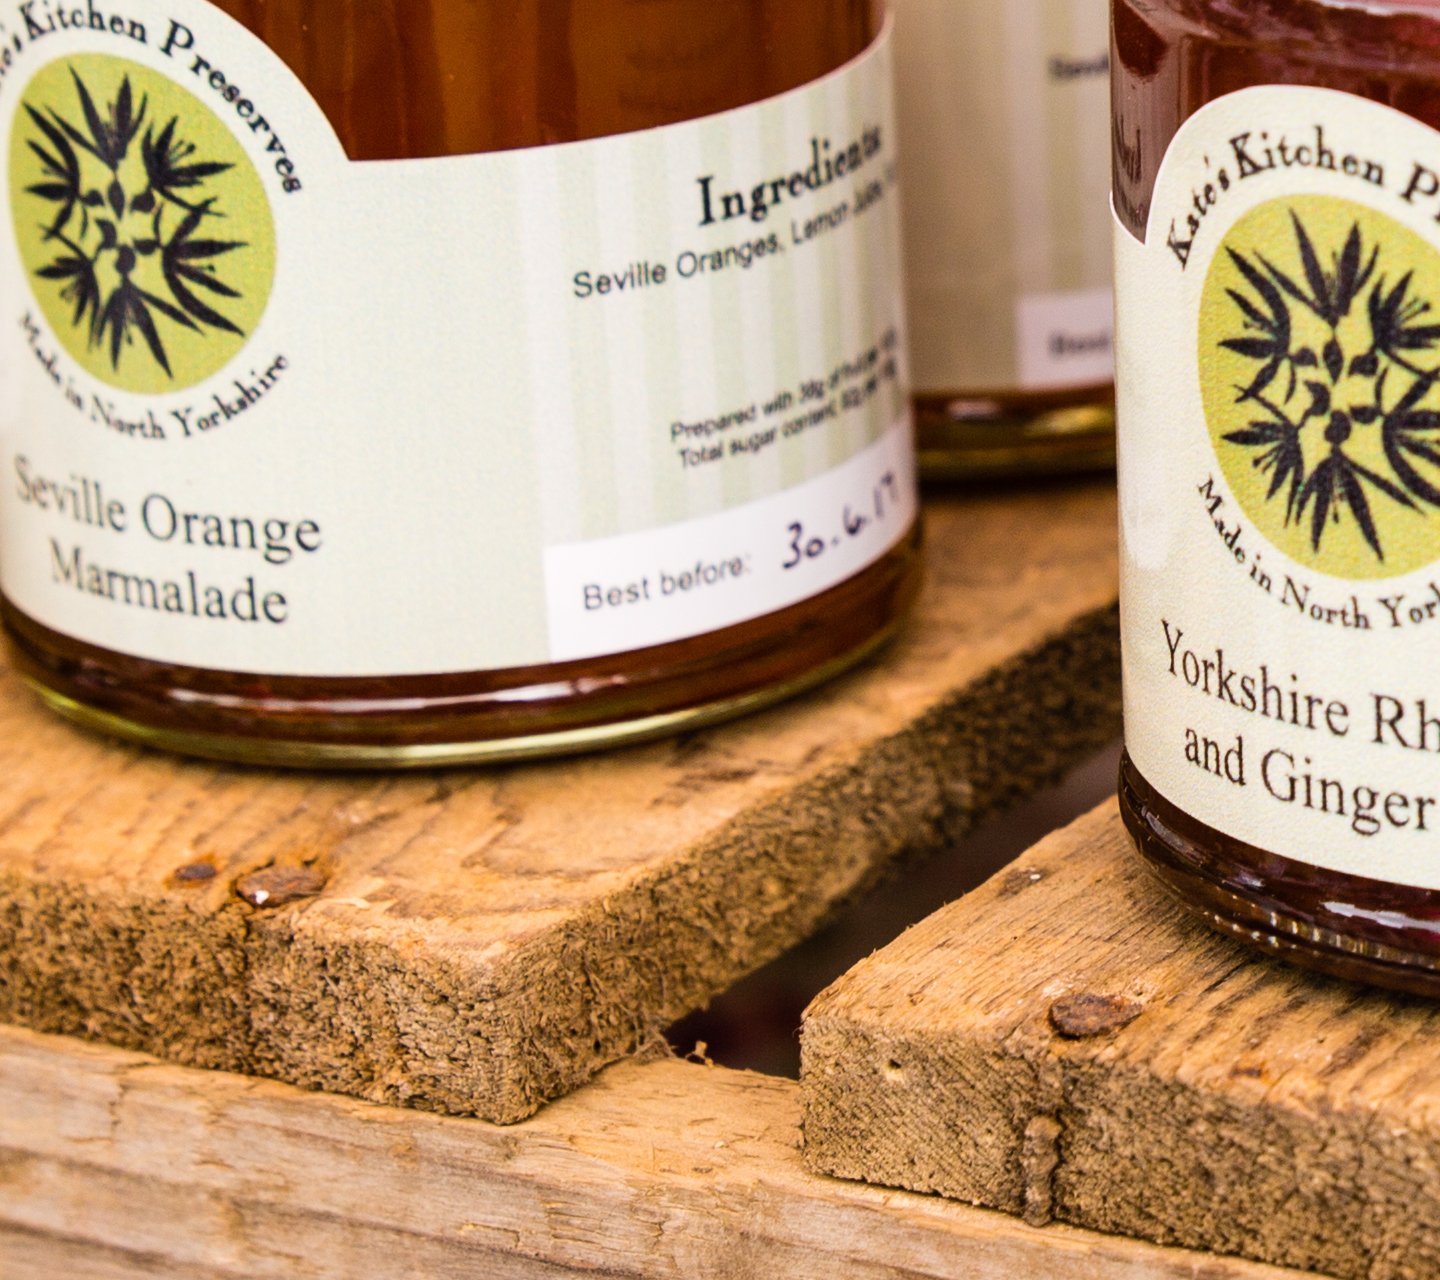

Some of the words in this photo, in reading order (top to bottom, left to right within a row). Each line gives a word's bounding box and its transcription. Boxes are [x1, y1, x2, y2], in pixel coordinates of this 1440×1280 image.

[159, 17, 302, 195] Preserves
[1166, 155, 1231, 272] Kate's
[1228, 125, 1386, 189] Kitchen
[572, 260, 667, 299] Seville
[86, 393, 167, 442] North
[168, 353, 291, 441] Yorkshire
[14, 451, 127, 534] Seville
[141, 492, 324, 566] Orange
[1196, 472, 1248, 563] Made
[1248, 554, 1276, 590] in
[1279, 574, 1373, 632] North
[49, 536, 290, 625] Marmalade
[582, 576, 652, 613] Best
[1160, 618, 1351, 738] Yorkshire
[1183, 725, 1248, 788] and
[1259, 747, 1437, 838] Ginger
